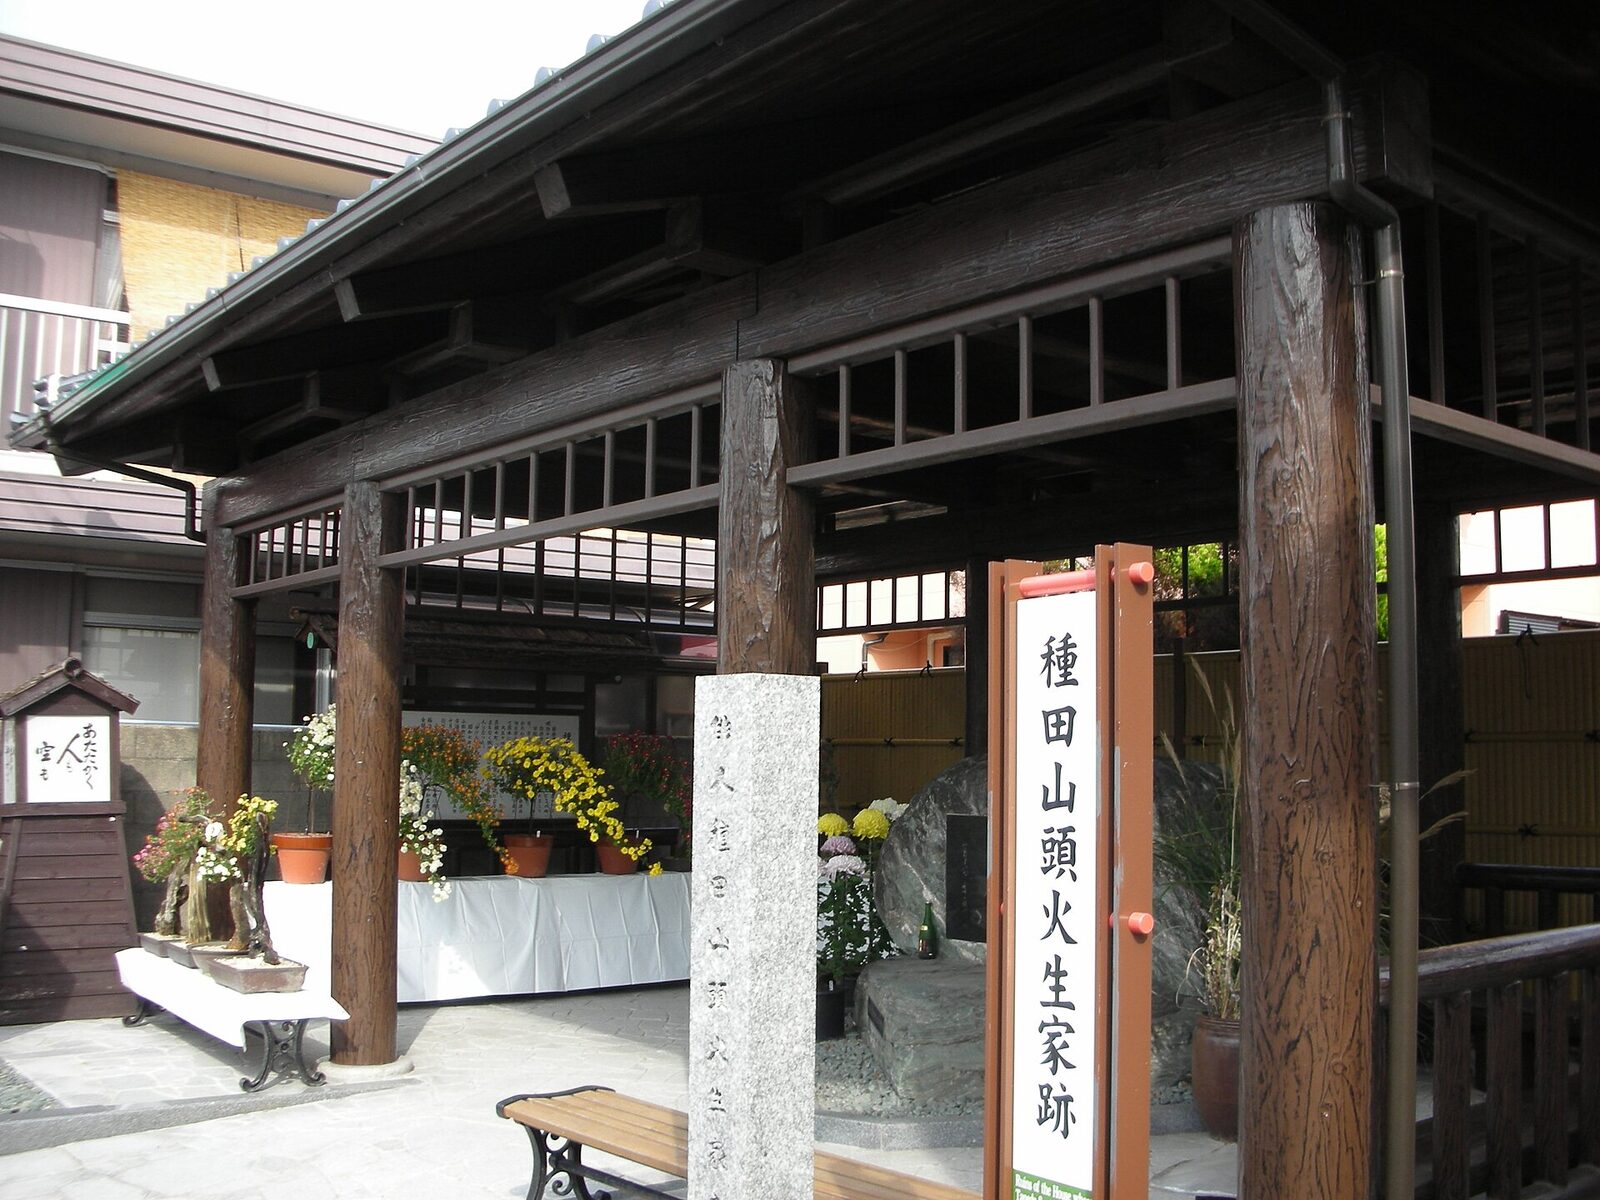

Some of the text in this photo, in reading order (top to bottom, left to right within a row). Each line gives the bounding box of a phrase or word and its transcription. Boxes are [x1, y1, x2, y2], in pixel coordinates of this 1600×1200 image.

[706, 714, 735, 1200] 俳人種田山頭火生家
[1036, 632, 1079, 1139] 種田山頭火生家跡
[1033, 1180, 1041, 1193] of
[1041, 1182, 1052, 1197] the
